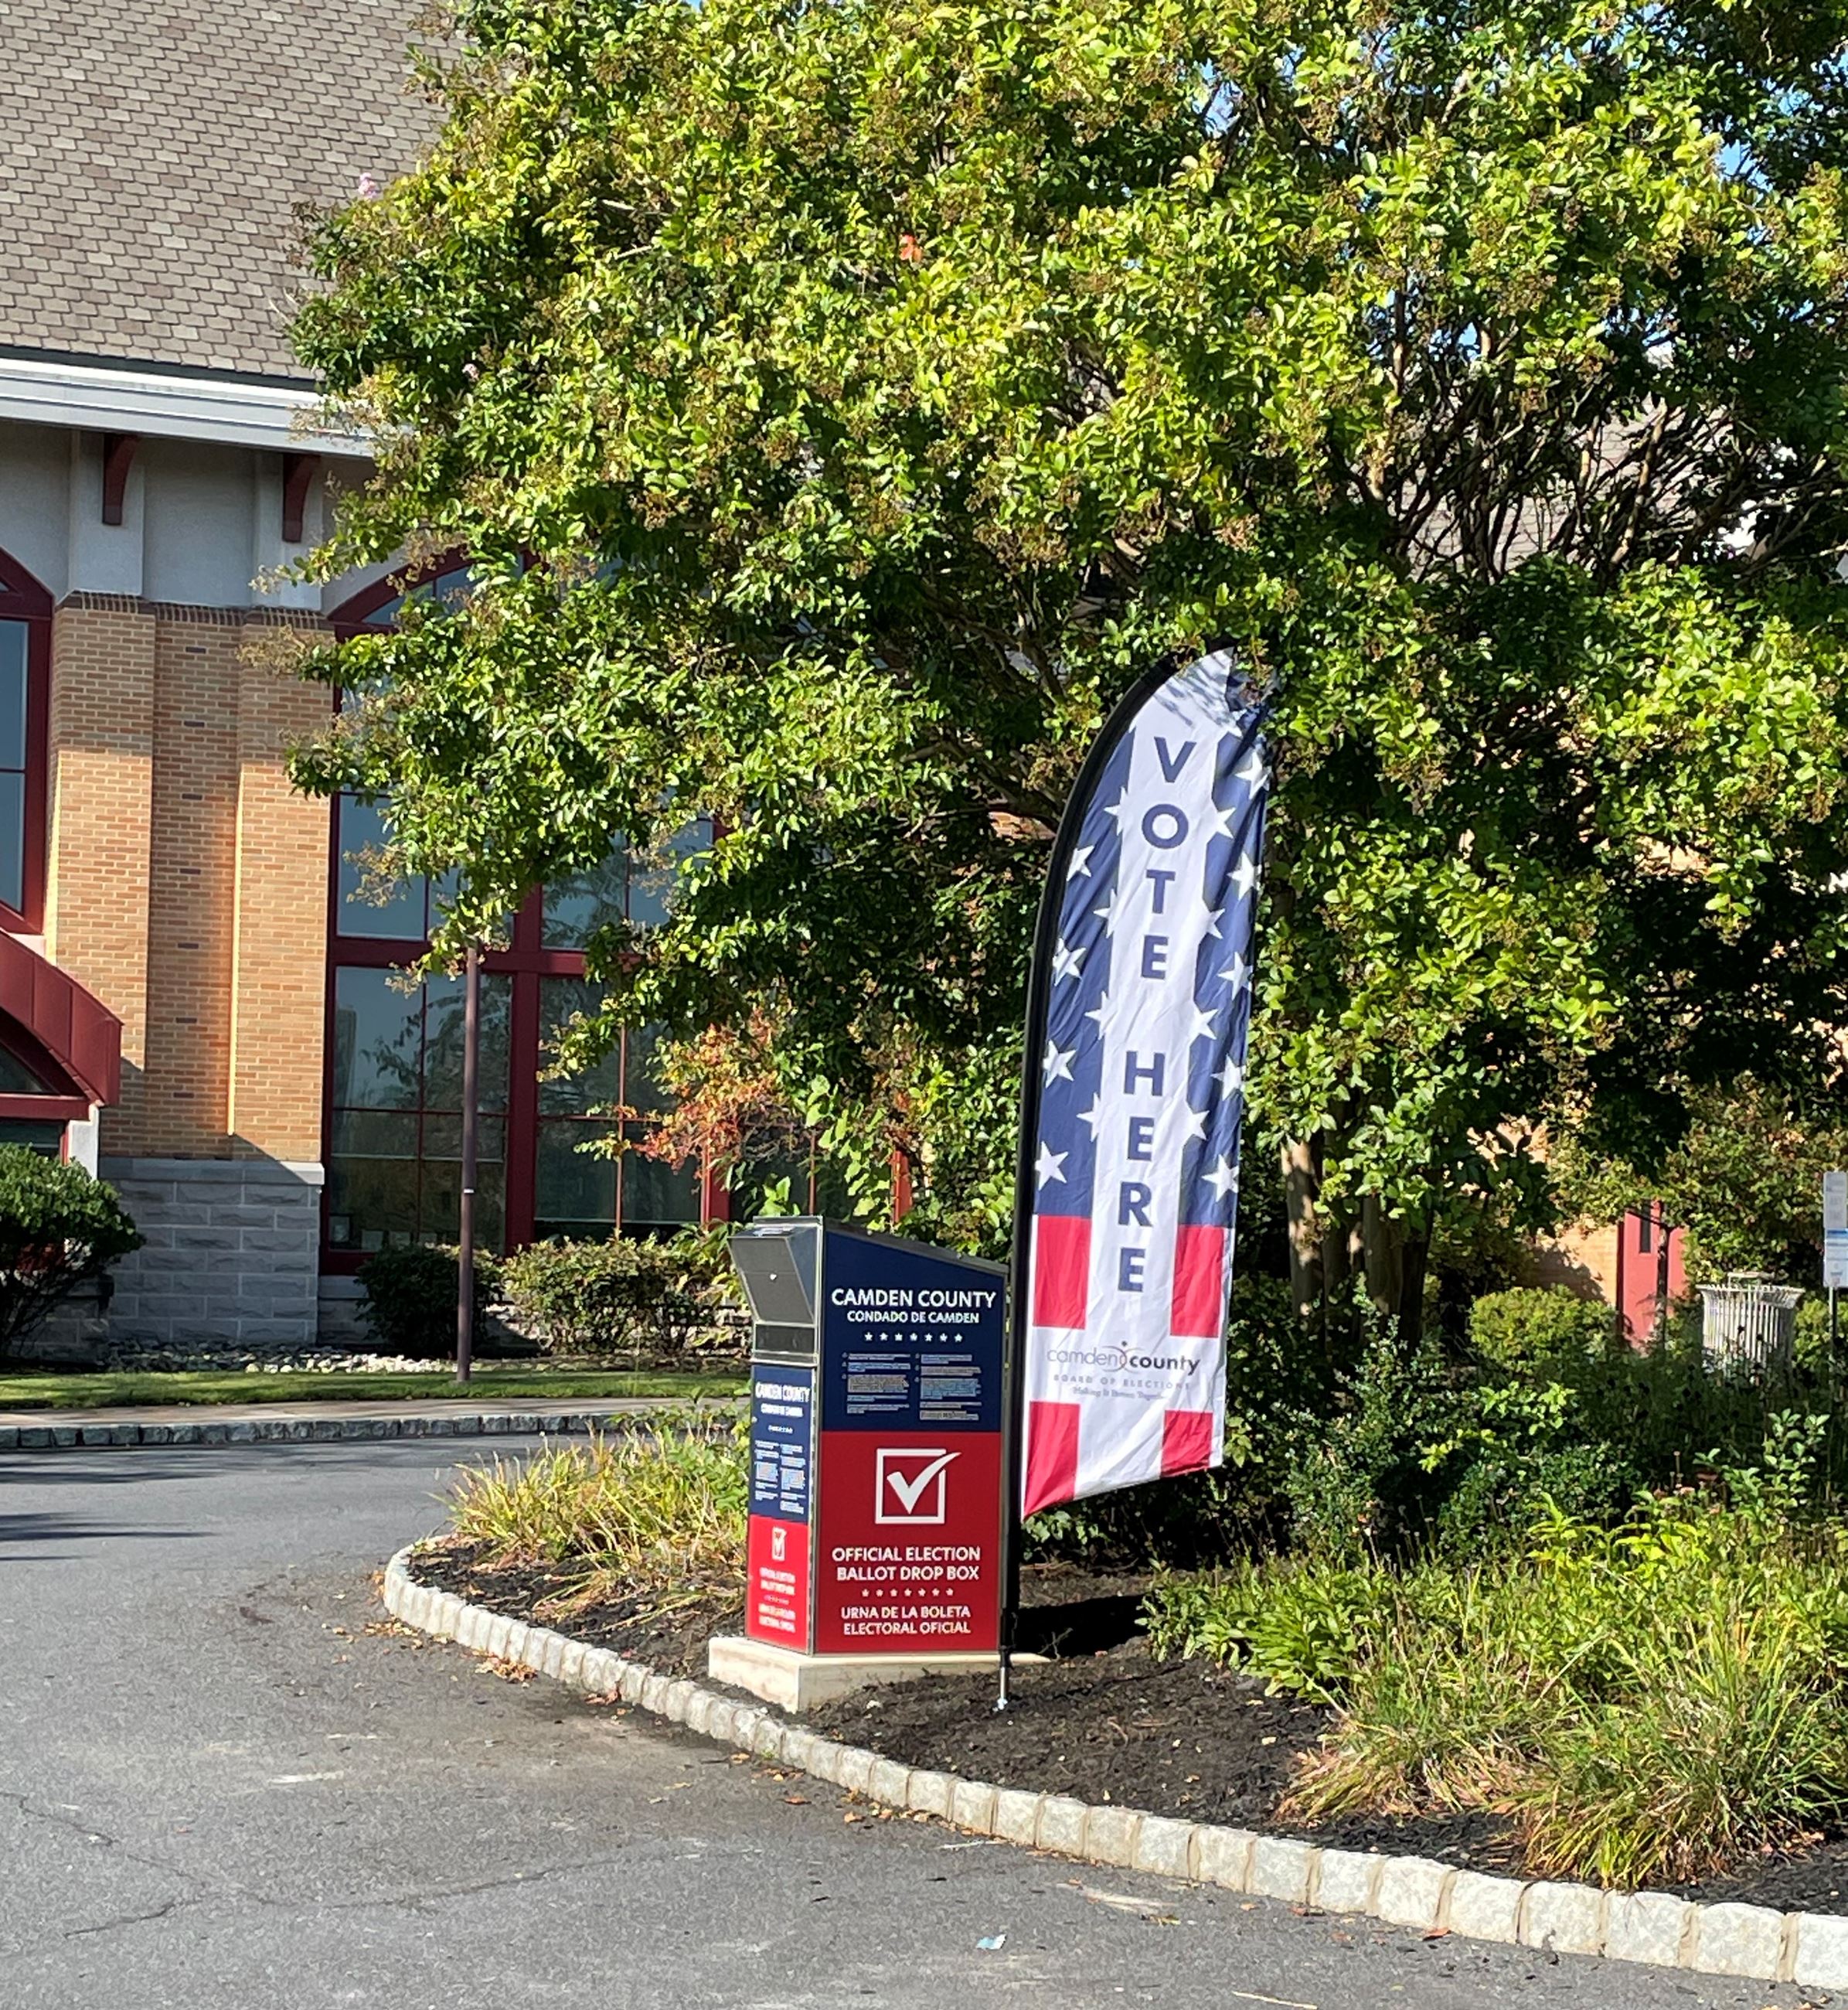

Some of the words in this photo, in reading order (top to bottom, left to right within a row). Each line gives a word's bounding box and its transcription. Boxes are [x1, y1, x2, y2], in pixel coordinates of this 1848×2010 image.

[1141, 737, 1197, 980] VOTE
[1118, 1051, 1166, 1292] HERE
[832, 1288, 913, 1306] CAMDEN
[918, 1290, 996, 1308] COUNTY
[847, 1310, 908, 1323] CONDADO
[911, 1311, 926, 1323] DE
[928, 1312, 979, 1324] CAMDEN
[1047, 1347, 1118, 1367] camden
[1129, 1354, 1200, 1375] county
[1053, 1375, 1093, 1384] BOARD
[1101, 1376, 1115, 1385] OF
[1123, 1379, 1190, 1390] ELECTIONS
[832, 1547, 903, 1562] OFFICIAL
[906, 1546, 981, 1561] ELECTION
[837, 1566, 897, 1581] BALLOT
[900, 1566, 944, 1580] DROP
[947, 1565, 979, 1580] BOX
[841, 1606, 879, 1620] URNA
[882, 1606, 899, 1619] DE
[901, 1606, 918, 1619] LA
[921, 1606, 971, 1618] BOLETA
[844, 1622, 917, 1635] ELECTORAL
[920, 1622, 971, 1634] OFICIAL
